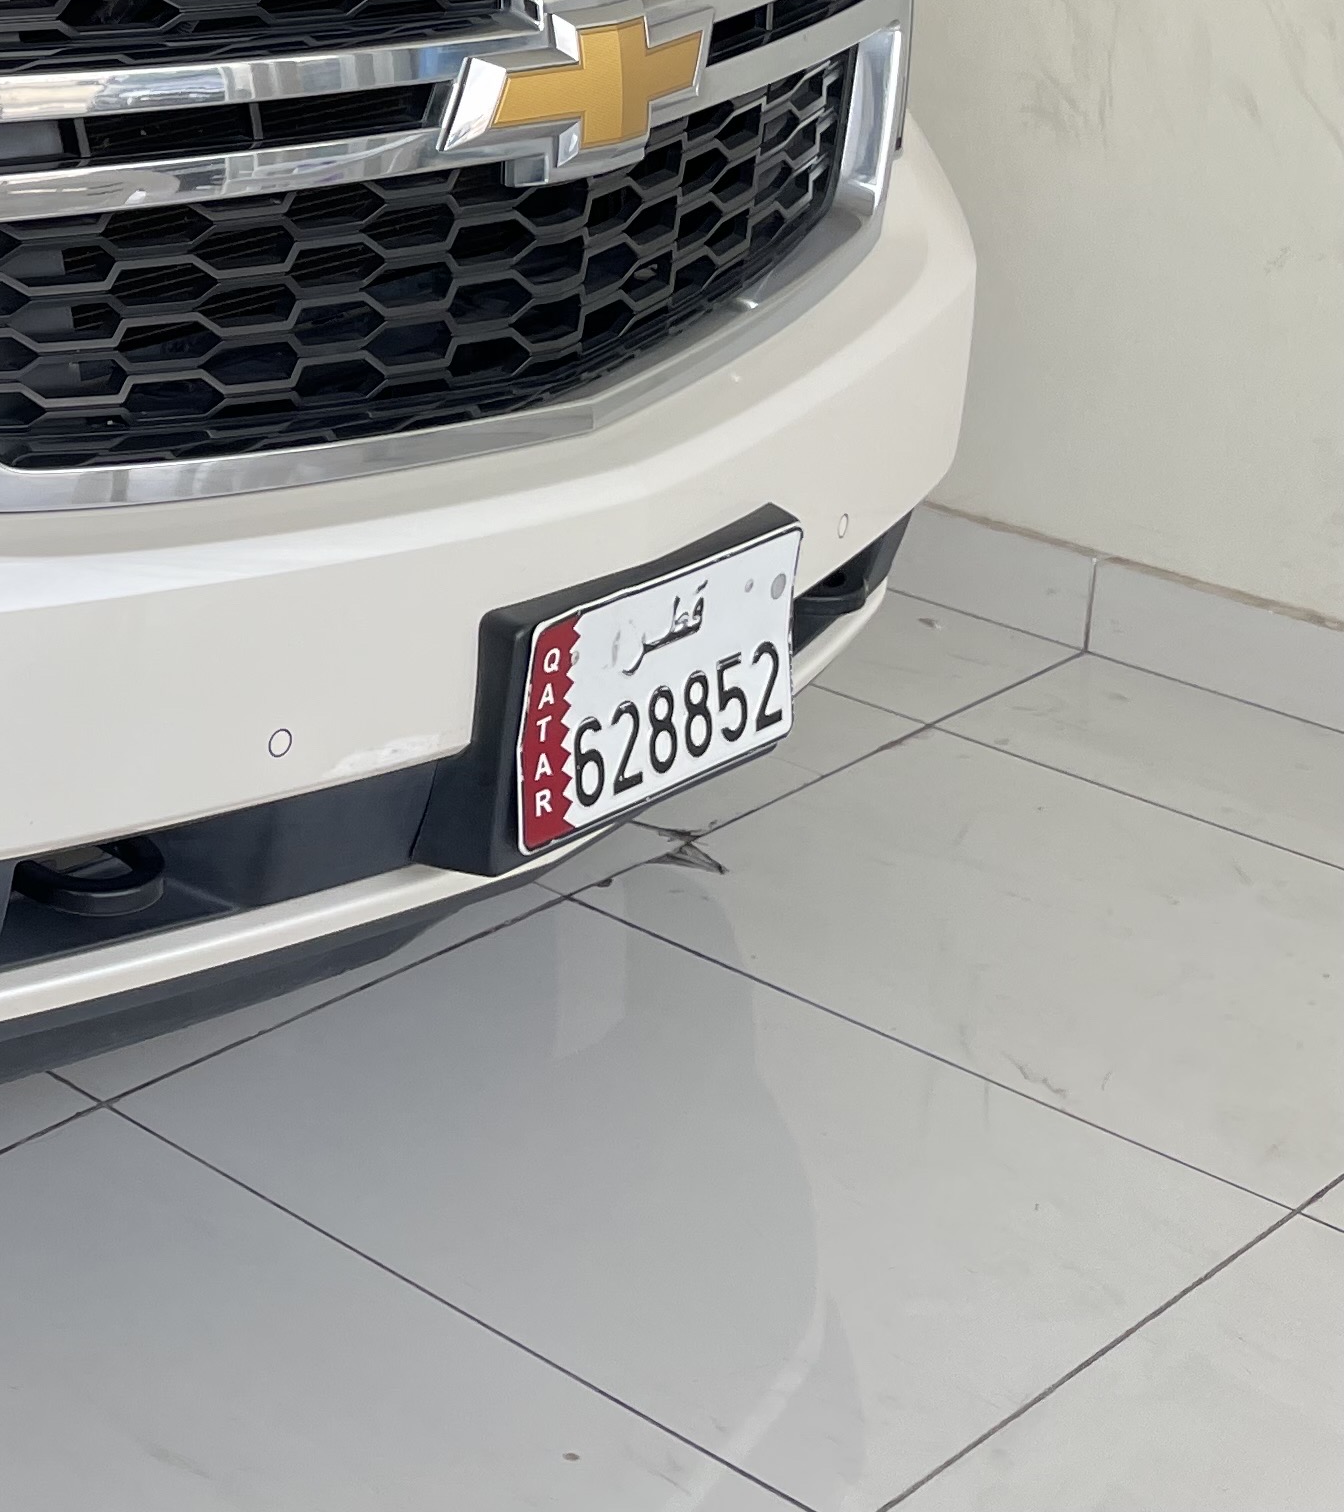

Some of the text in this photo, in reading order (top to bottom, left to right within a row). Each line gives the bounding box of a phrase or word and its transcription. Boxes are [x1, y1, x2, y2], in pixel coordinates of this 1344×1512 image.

[622, 579, 709, 676] قطر
[533, 645, 563, 818] QATAR
[573, 640, 784, 808] 628852
